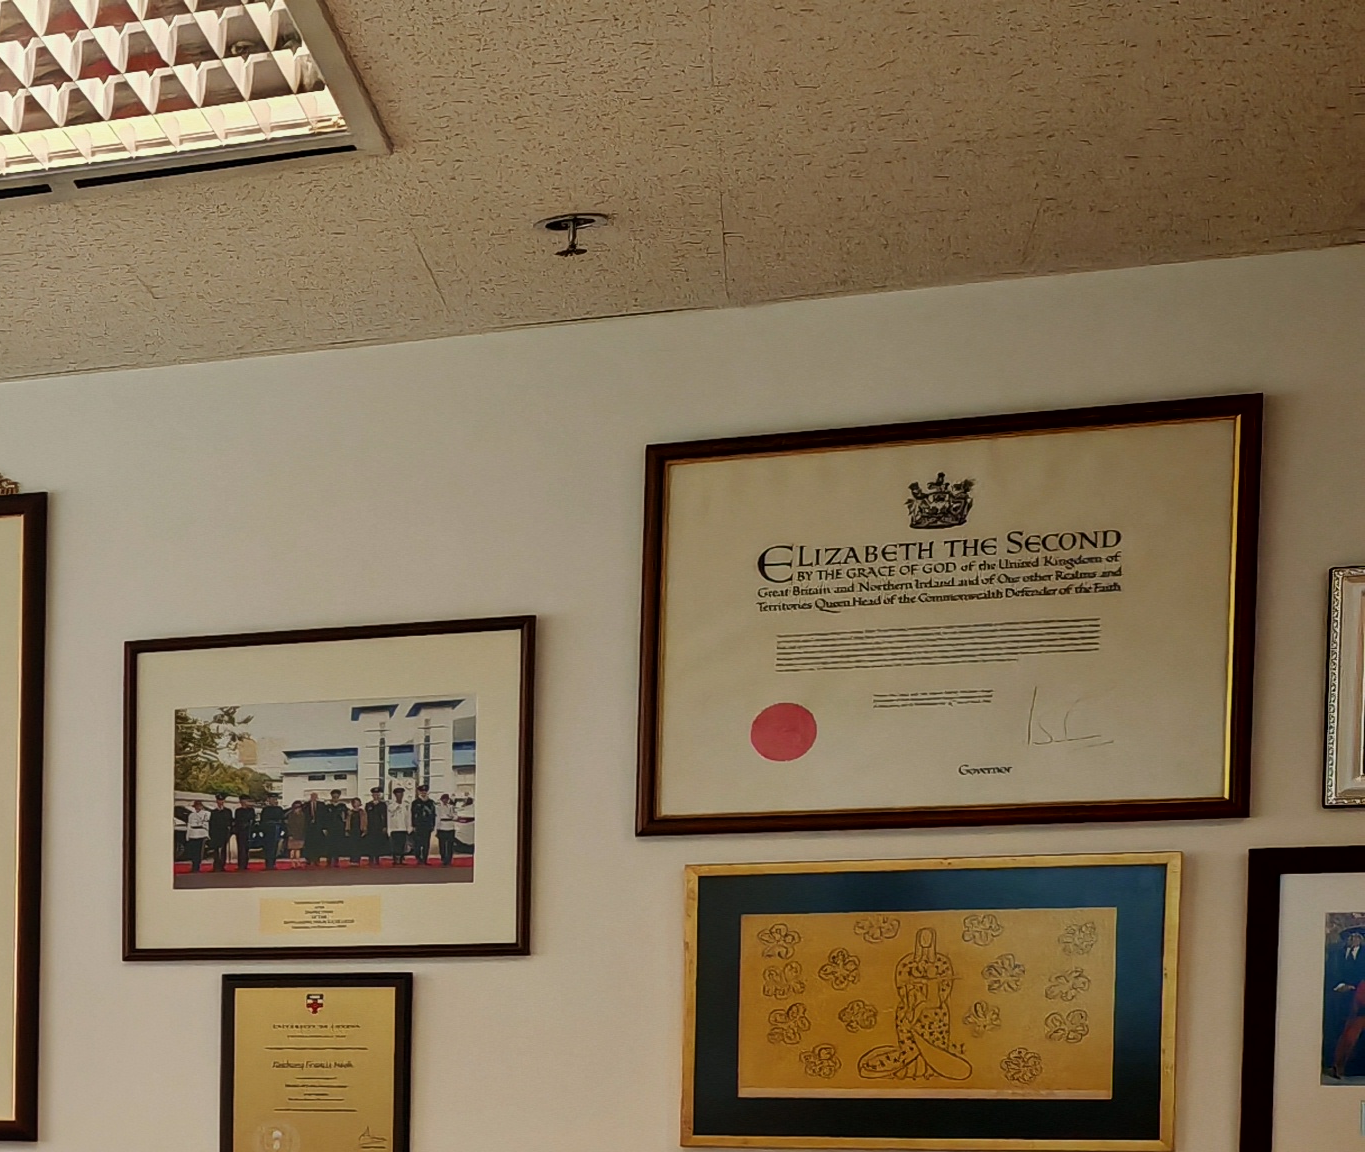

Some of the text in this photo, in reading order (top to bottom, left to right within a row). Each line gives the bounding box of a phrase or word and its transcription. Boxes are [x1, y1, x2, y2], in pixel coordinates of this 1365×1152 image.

[757, 529, 1122, 583] ELIZABETH THE SECOND
[796, 571, 813, 582] BY
[817, 568, 842, 581] THE
[846, 565, 896, 579] GRACE
[899, 564, 919, 576] OF
[922, 562, 956, 574] GOD
[961, 561, 976, 572] of
[1043, 554, 1102, 569] Kingdom
[958, 764, 1013, 777] Governor
